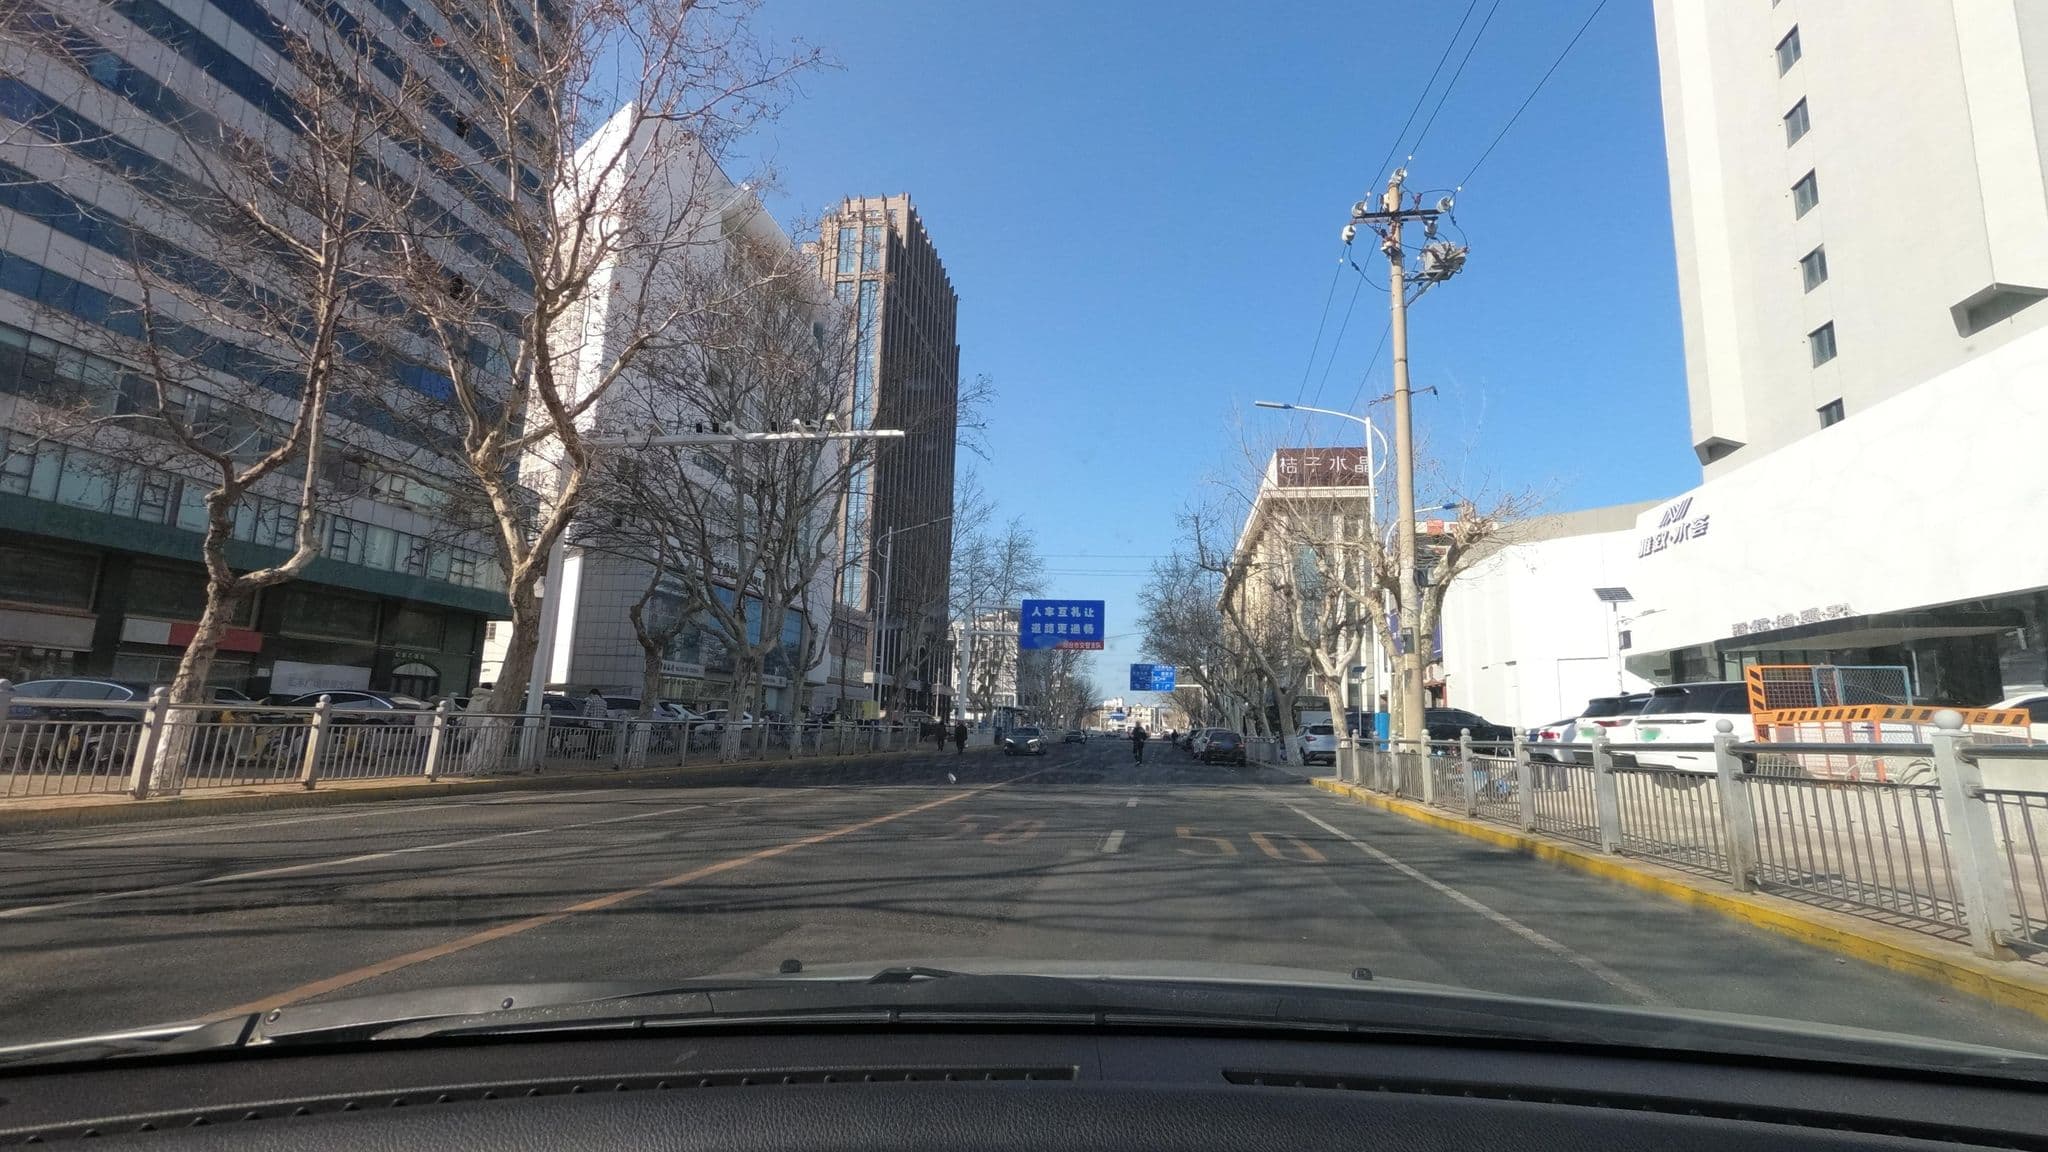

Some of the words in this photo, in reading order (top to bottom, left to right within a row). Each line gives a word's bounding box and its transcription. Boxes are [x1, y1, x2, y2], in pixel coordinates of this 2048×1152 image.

[1280, 456, 1369, 474] 桔子水晶
[1031, 606, 1095, 618] 人车互礼让
[1031, 623, 1095, 635] 道路更通畅
